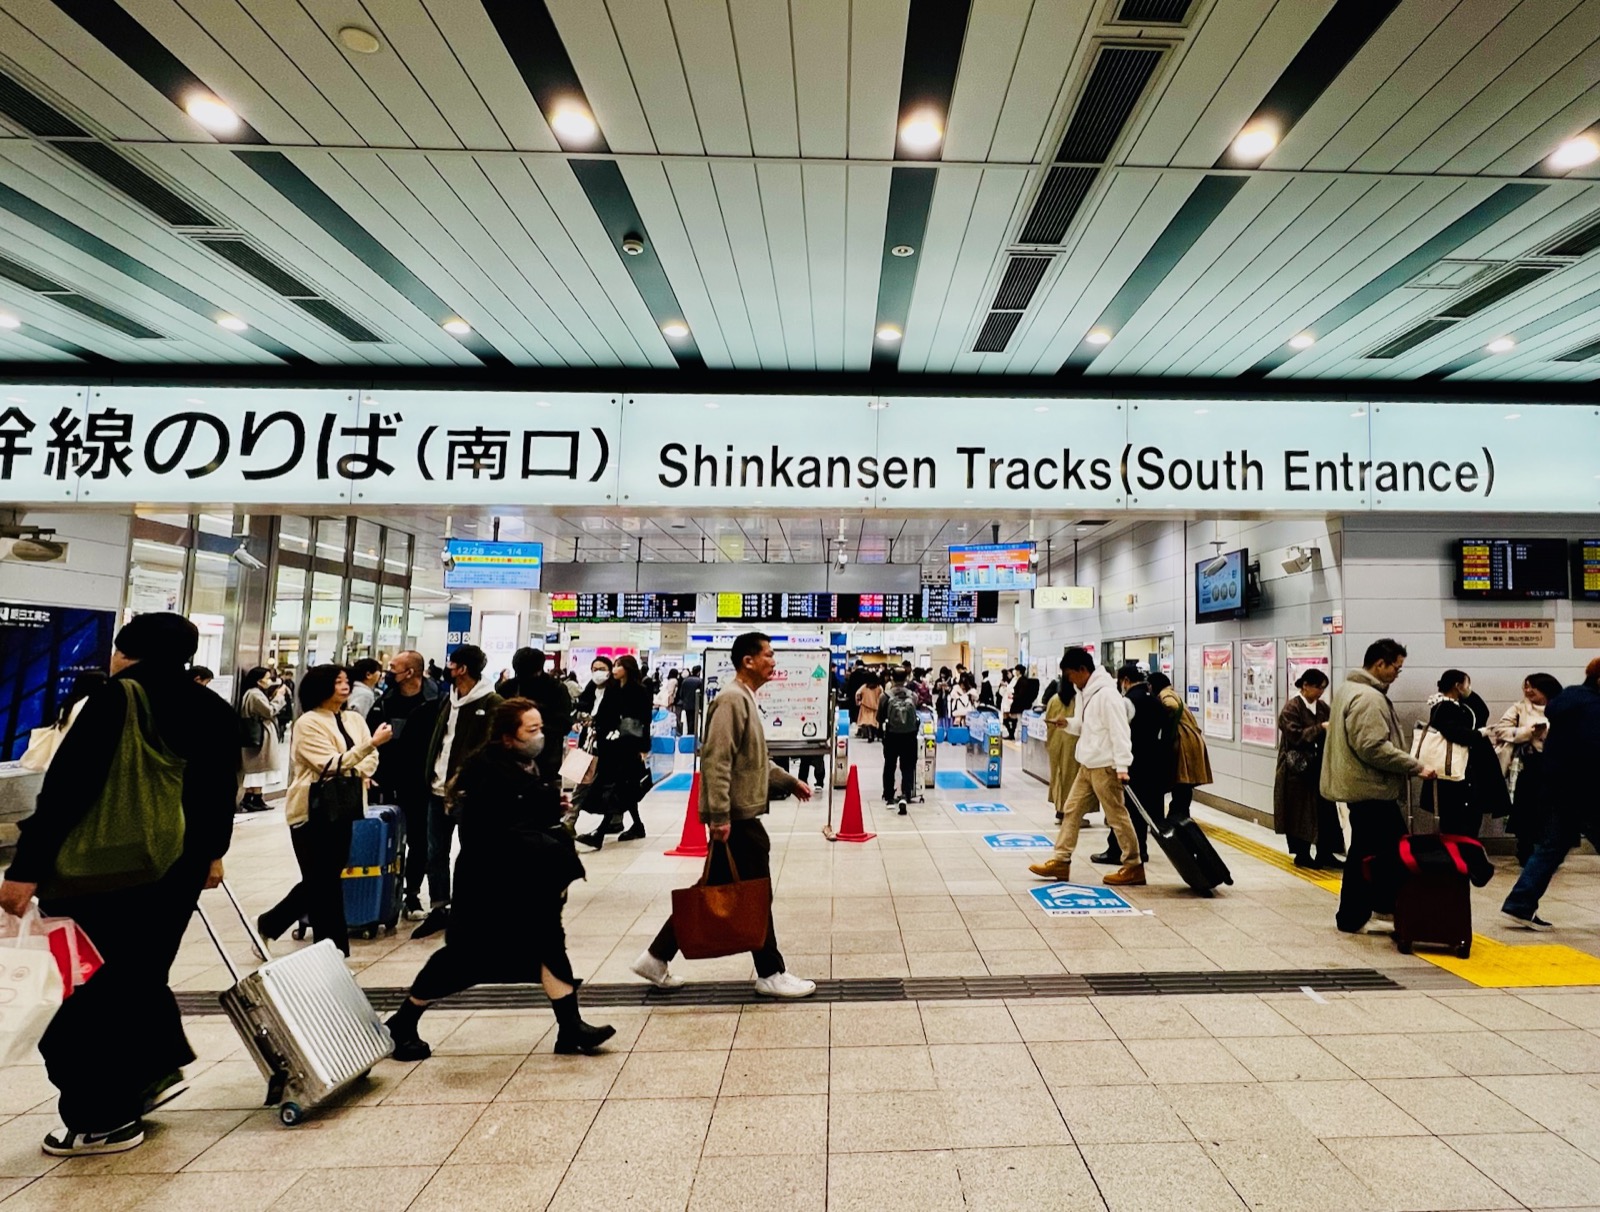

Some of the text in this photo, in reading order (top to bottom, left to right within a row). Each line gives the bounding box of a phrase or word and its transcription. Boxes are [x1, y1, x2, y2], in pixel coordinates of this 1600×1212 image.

[658, 443, 936, 489] Shinkansen
[1284, 446, 1495, 497] Entrance)
[449, 633, 459, 642] 23
